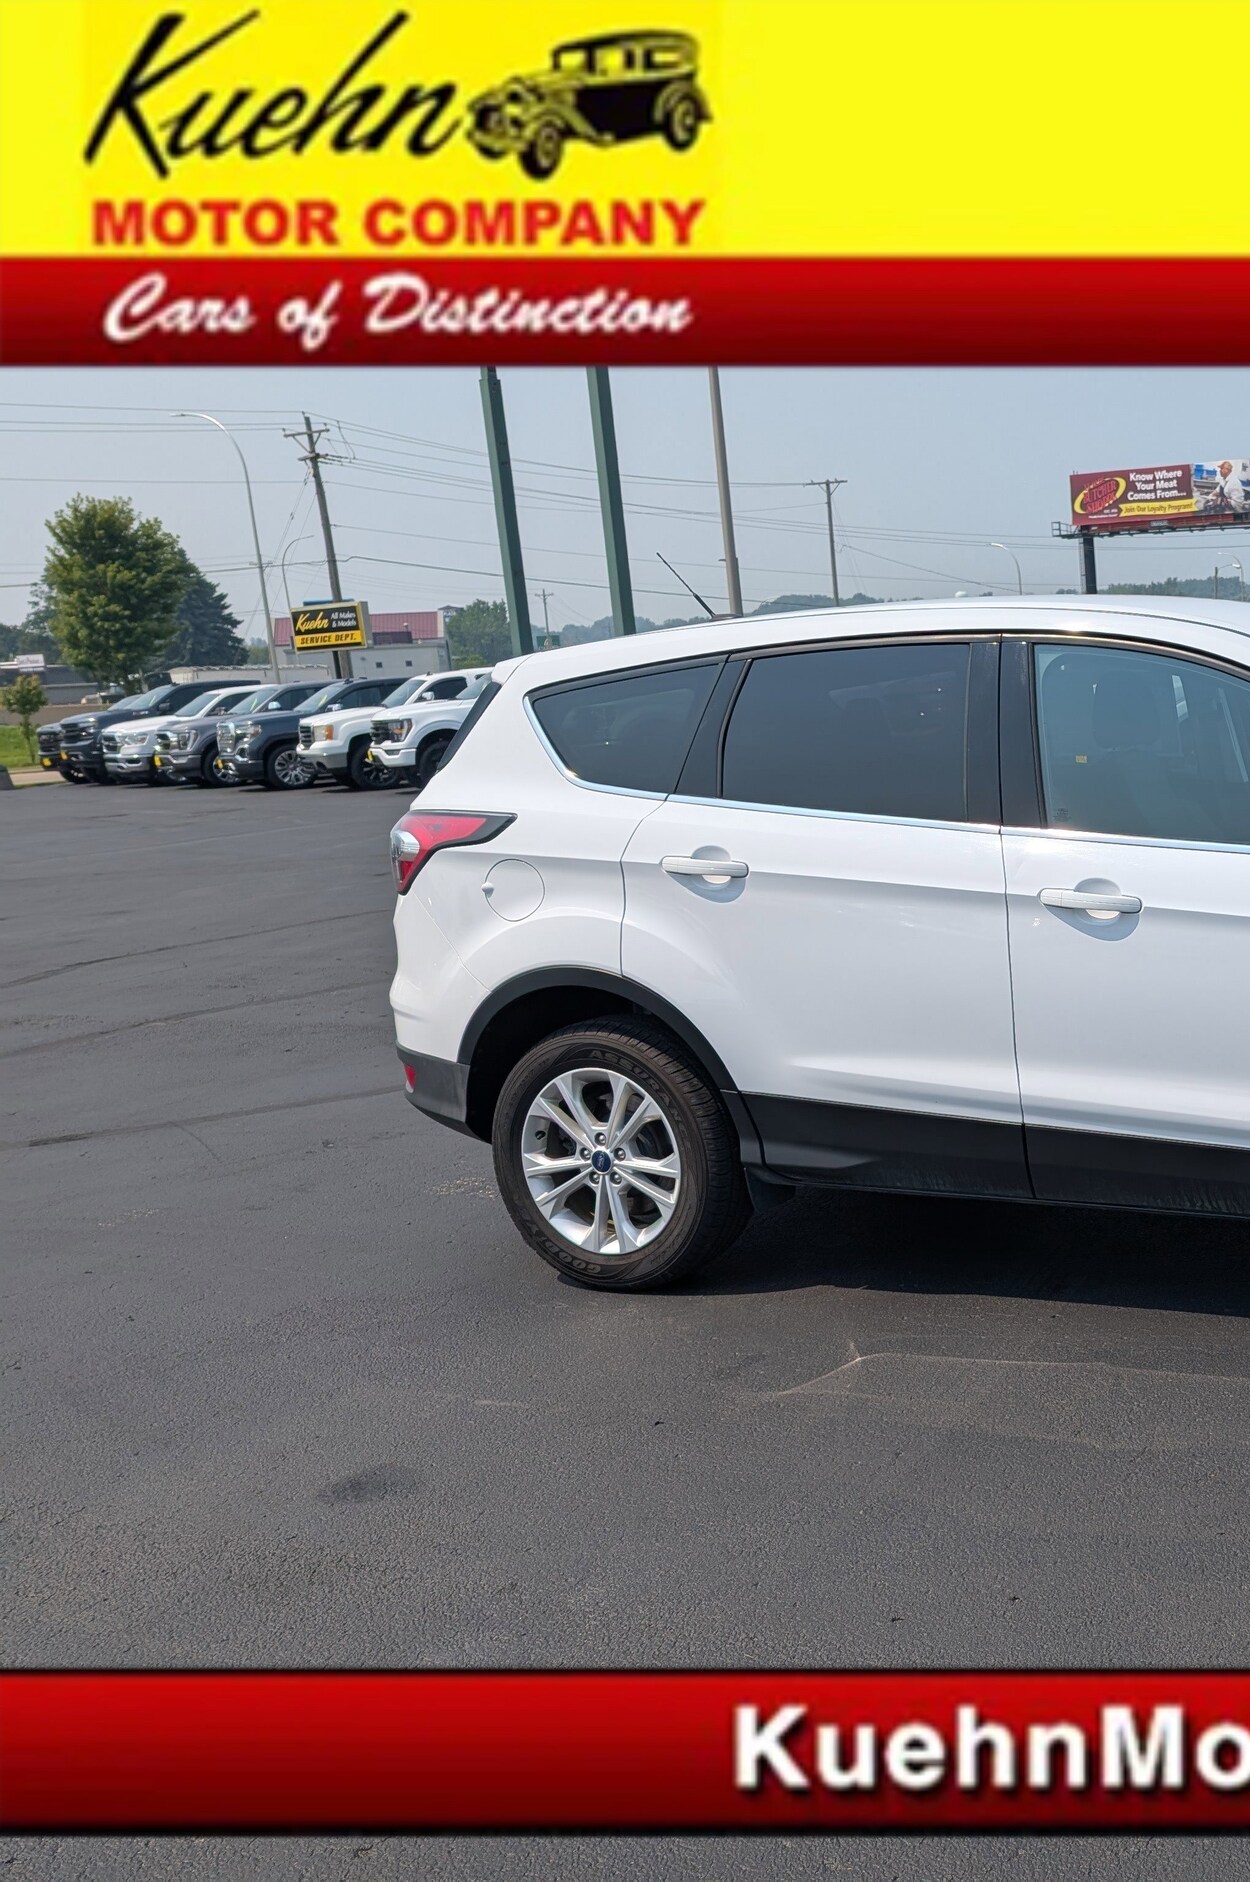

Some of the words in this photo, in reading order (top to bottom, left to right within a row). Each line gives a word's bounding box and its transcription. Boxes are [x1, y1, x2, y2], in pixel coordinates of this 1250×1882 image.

[1129, 472, 1154, 481] Know
[1154, 470, 1183, 480] Where
[1135, 481, 1155, 491] Your
[1155, 479, 1178, 490] Meat
[1127, 491, 1156, 501] Comes
[1124, 506, 1135, 514] Join
[1147, 504, 1167, 513] Loyalty
[295, 611, 330, 633] Kuehn
[331, 612, 339, 620] All
[339, 611, 356, 619] Makes
[337, 619, 357, 628] Models
[300, 635, 332, 645] SERVICE
[335, 633, 357, 642] DEPT.
